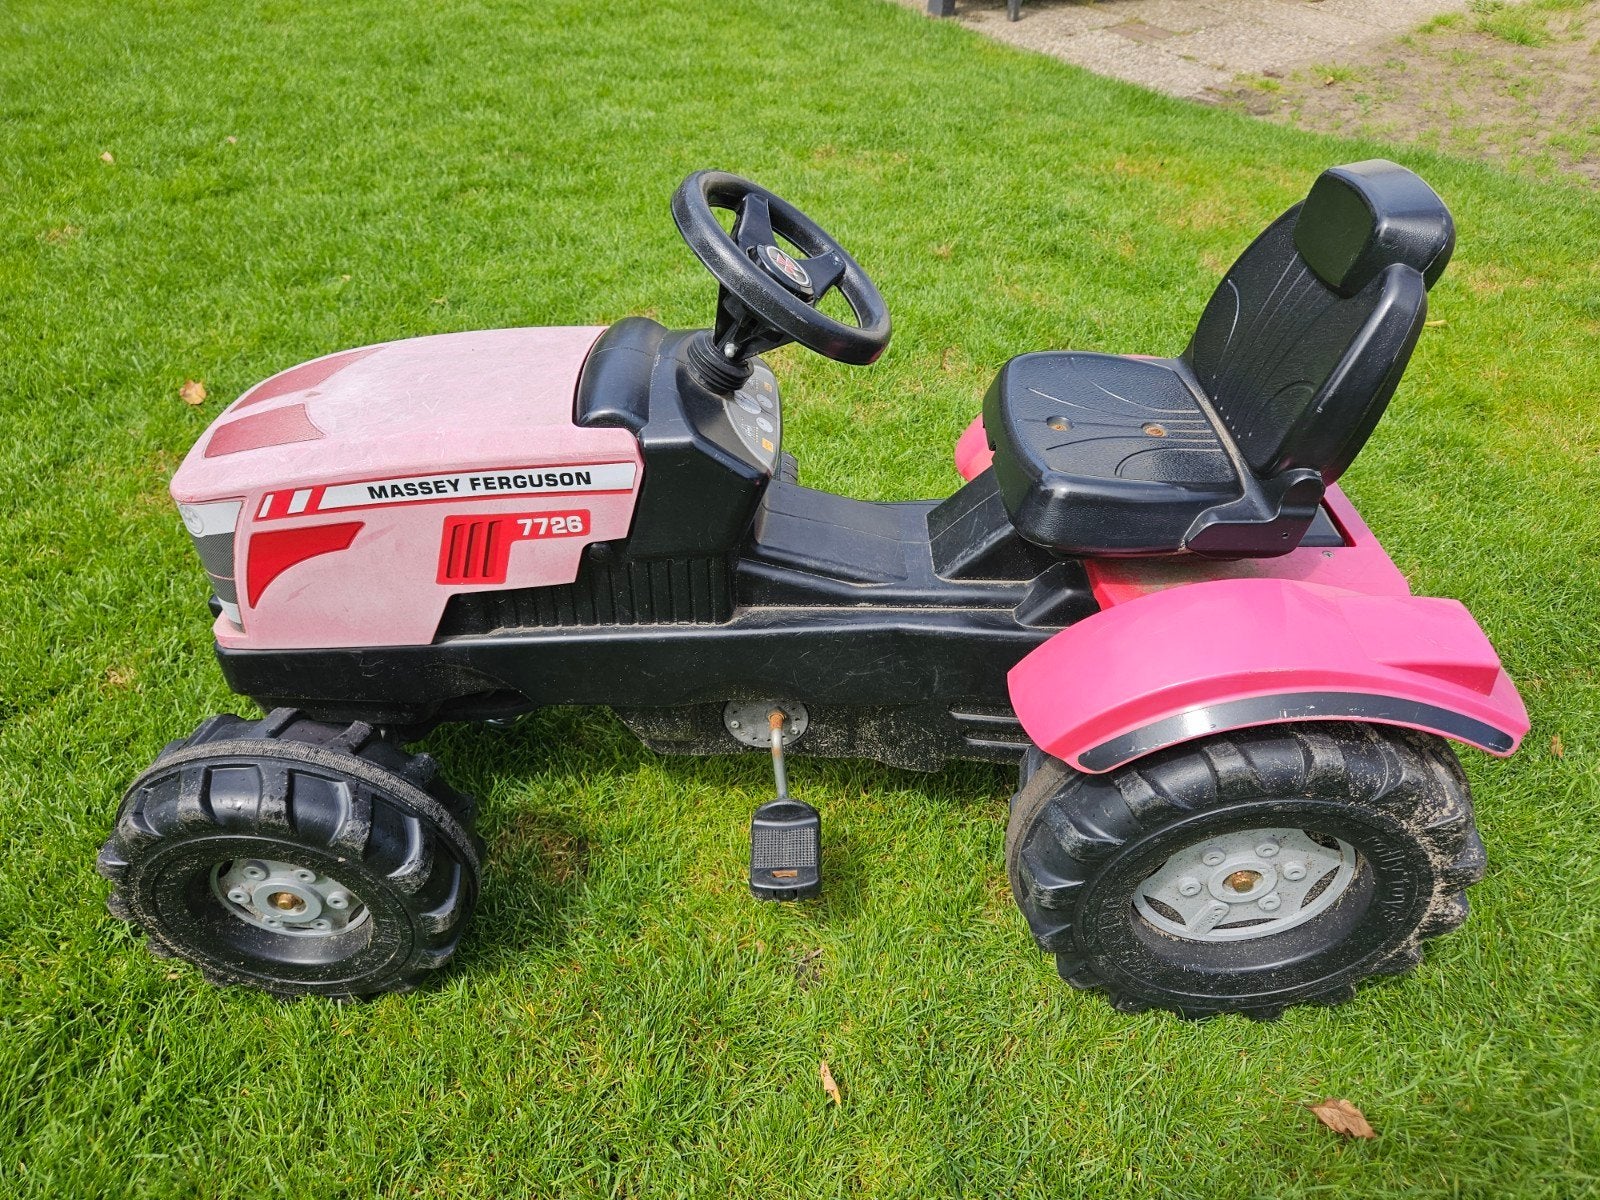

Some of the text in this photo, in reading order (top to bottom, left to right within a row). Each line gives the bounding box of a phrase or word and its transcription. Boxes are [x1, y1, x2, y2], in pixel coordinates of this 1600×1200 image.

[367, 471, 592, 500] MASSEY FERGUSON
[516, 515, 583, 536] 7726
